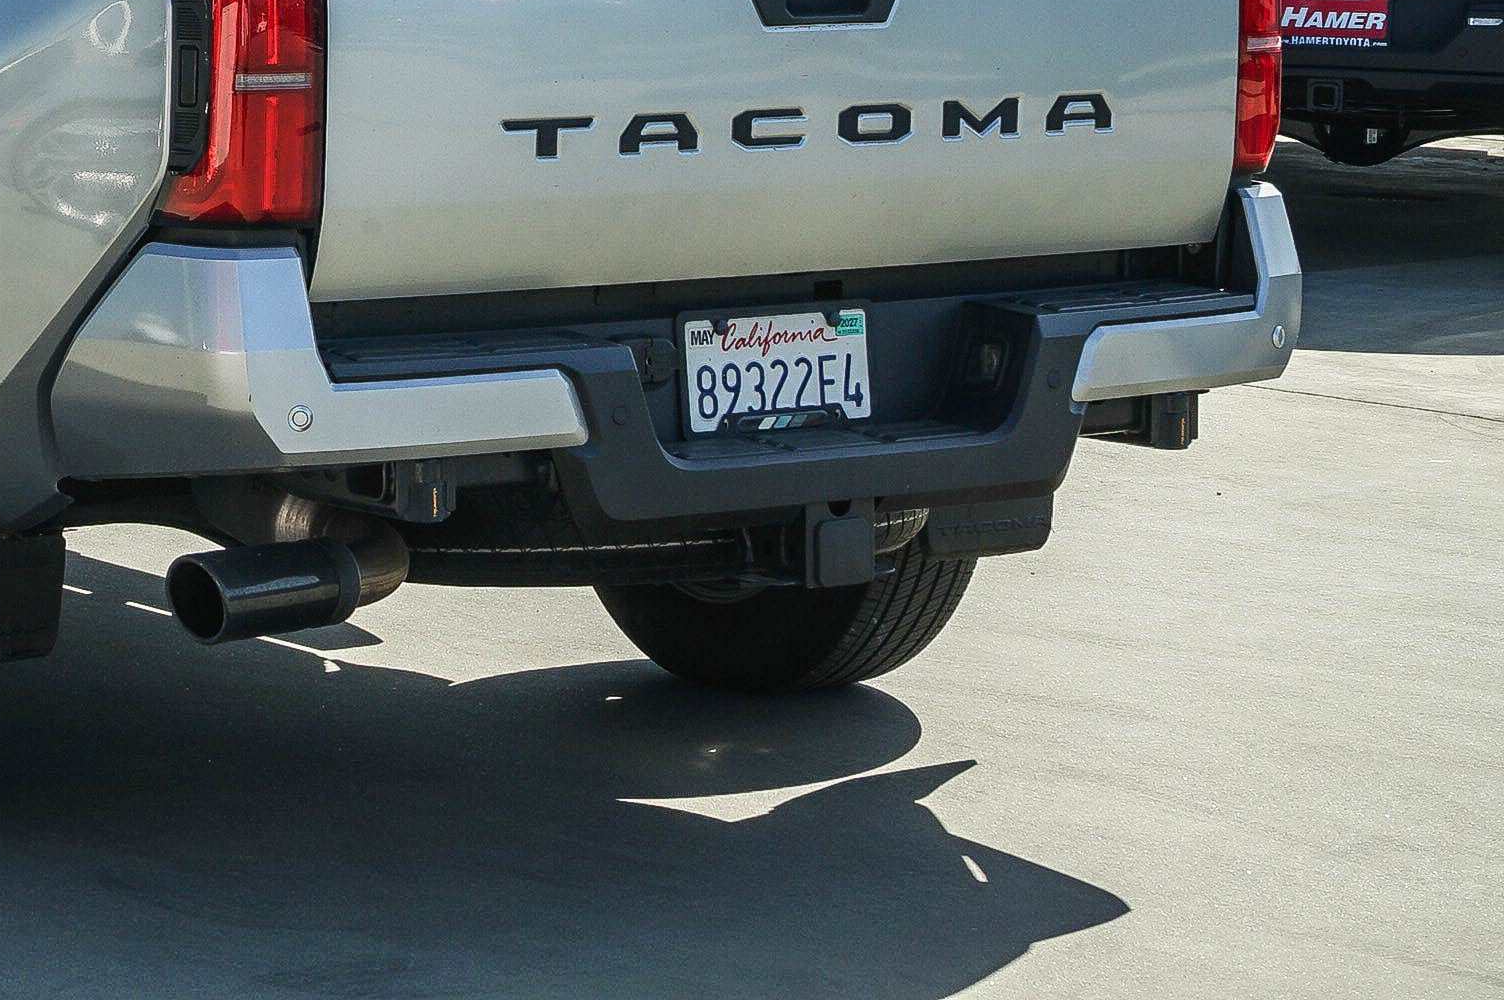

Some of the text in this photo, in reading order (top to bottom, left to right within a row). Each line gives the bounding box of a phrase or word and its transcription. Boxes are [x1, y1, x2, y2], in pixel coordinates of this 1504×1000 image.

[1280, 6, 1387, 30] HAMER
[499, 90, 1114, 161] TACOMA
[840, 317, 859, 328] 2027
[691, 329, 715, 346] MAY
[721, 320, 838, 357] California
